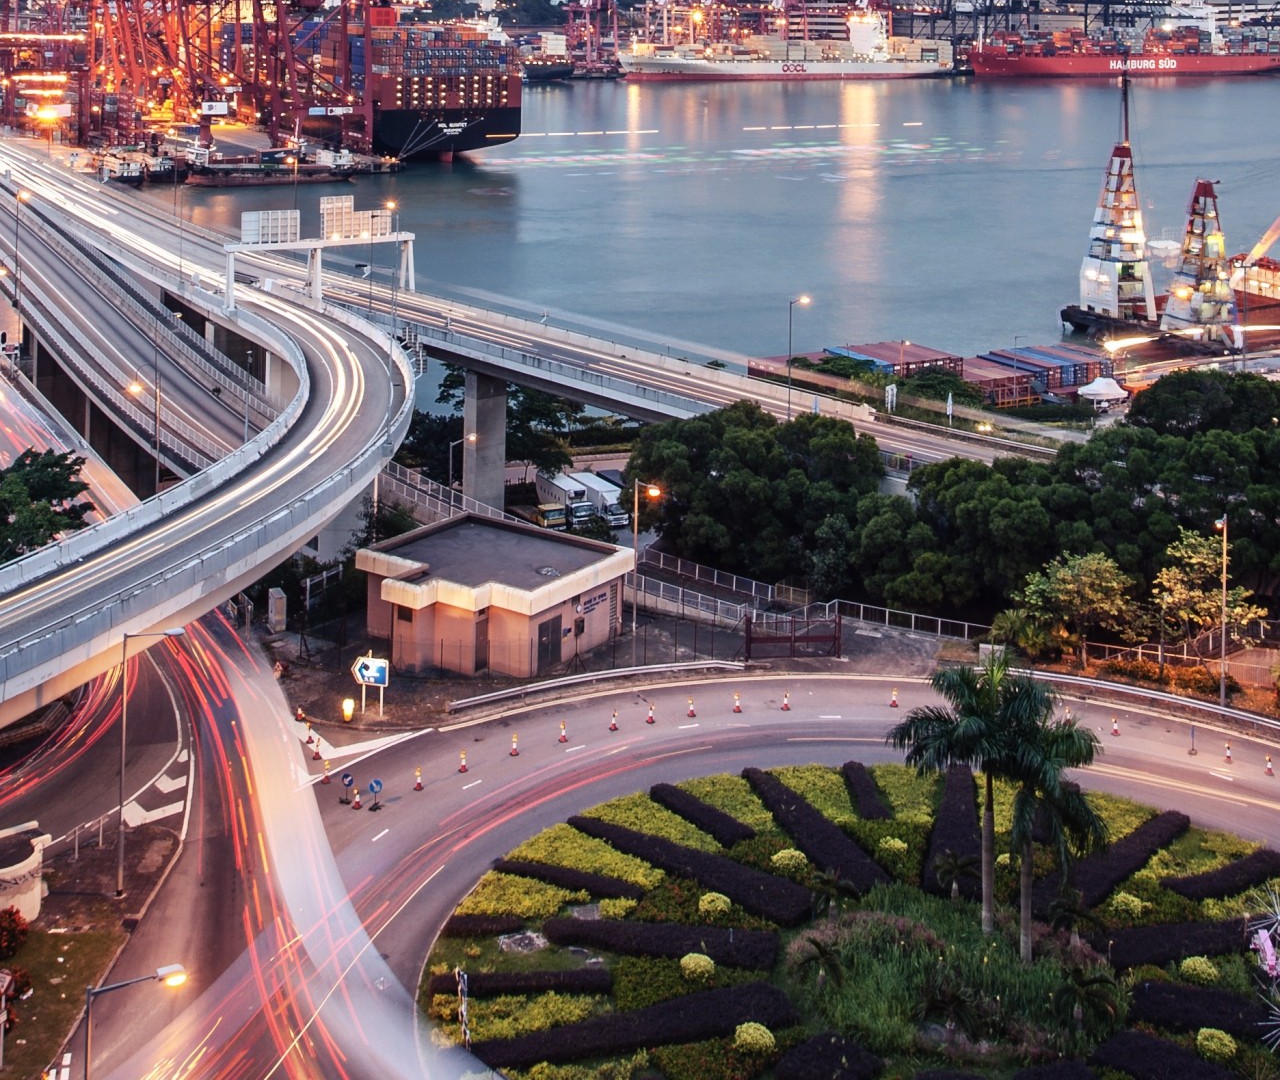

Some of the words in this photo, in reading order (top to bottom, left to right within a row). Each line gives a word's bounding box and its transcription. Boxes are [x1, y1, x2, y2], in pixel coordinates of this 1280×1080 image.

[782, 63, 807, 73] OOCL
[1109, 59, 1156, 70] HAMBURG
[1158, 57, 1177, 69] SÜD
